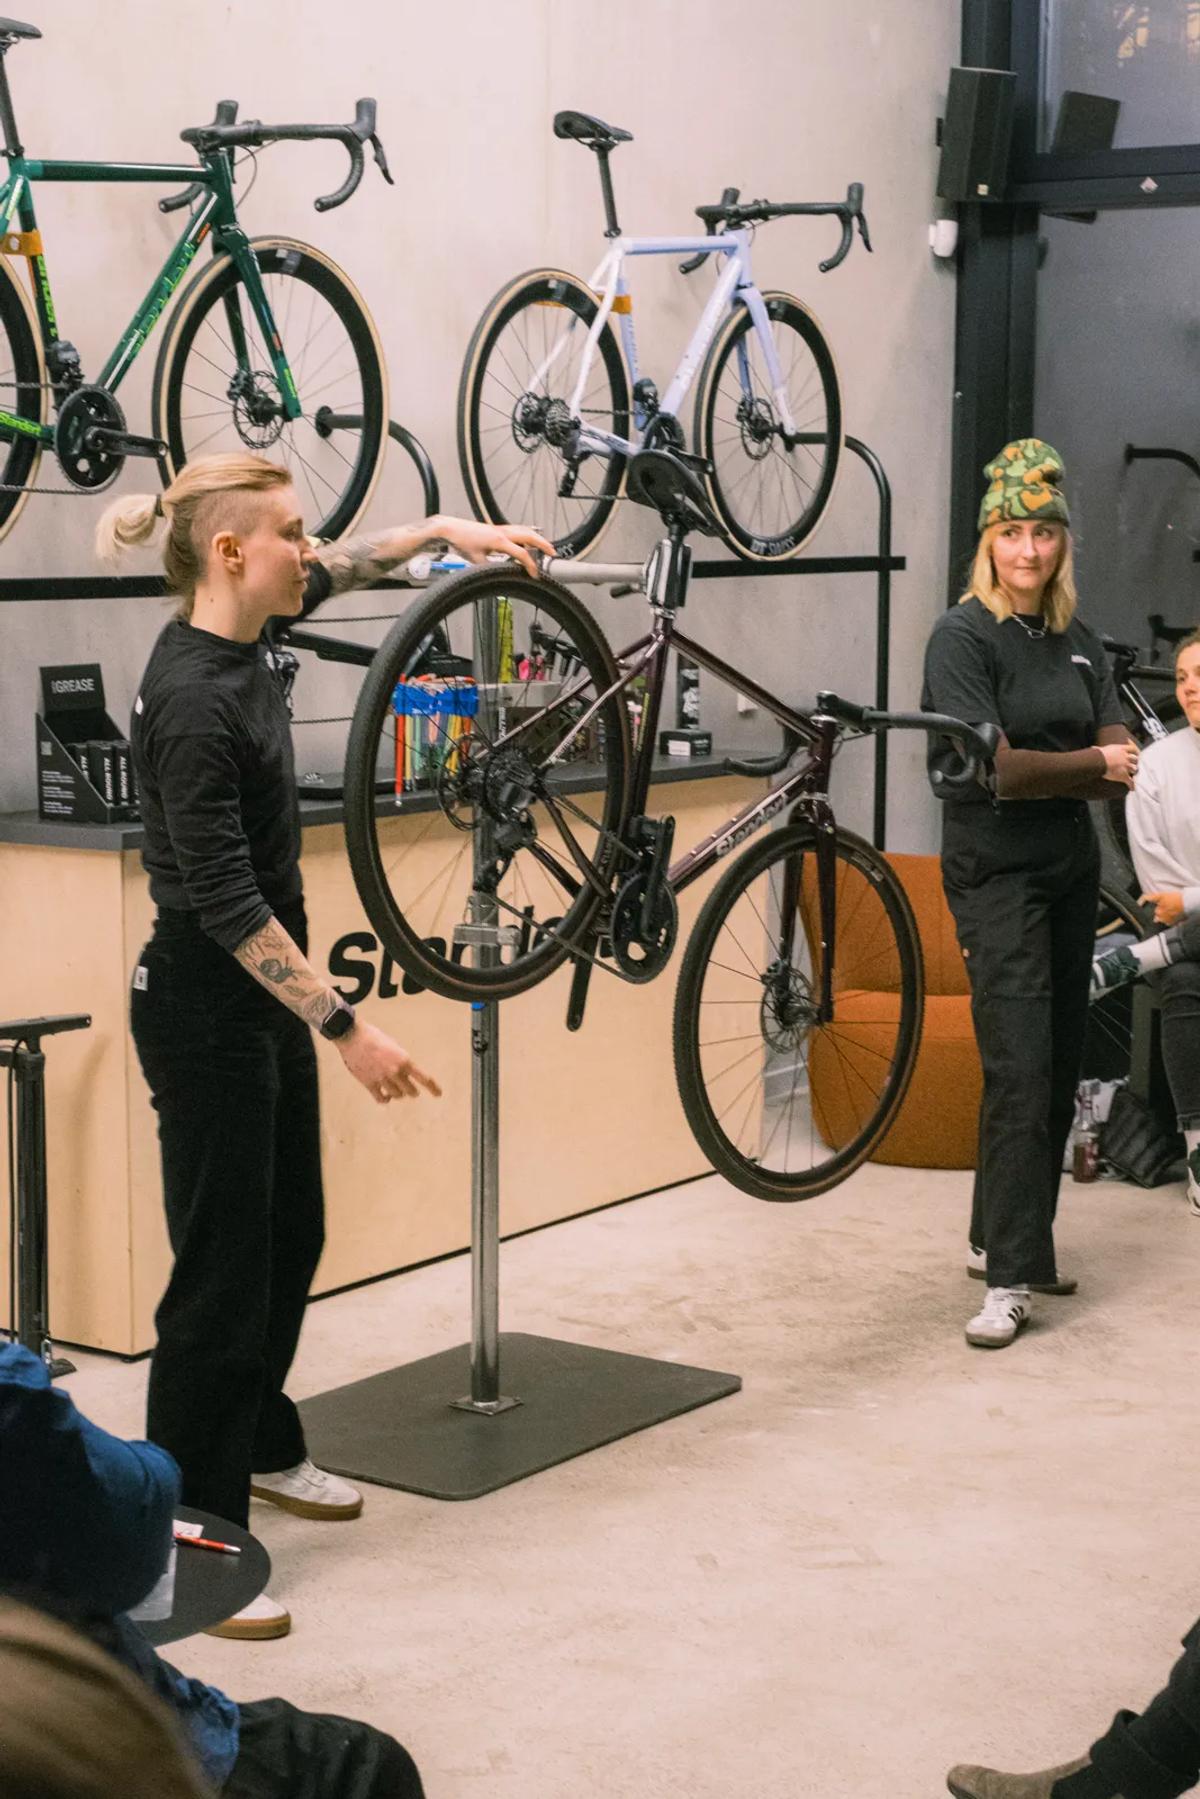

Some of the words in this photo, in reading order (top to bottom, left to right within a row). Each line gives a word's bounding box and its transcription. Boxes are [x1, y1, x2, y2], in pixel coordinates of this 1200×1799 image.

[55, 678, 95, 693] GREASE
[103, 757, 111, 771] ALL
[119, 755, 128, 770] ALL
